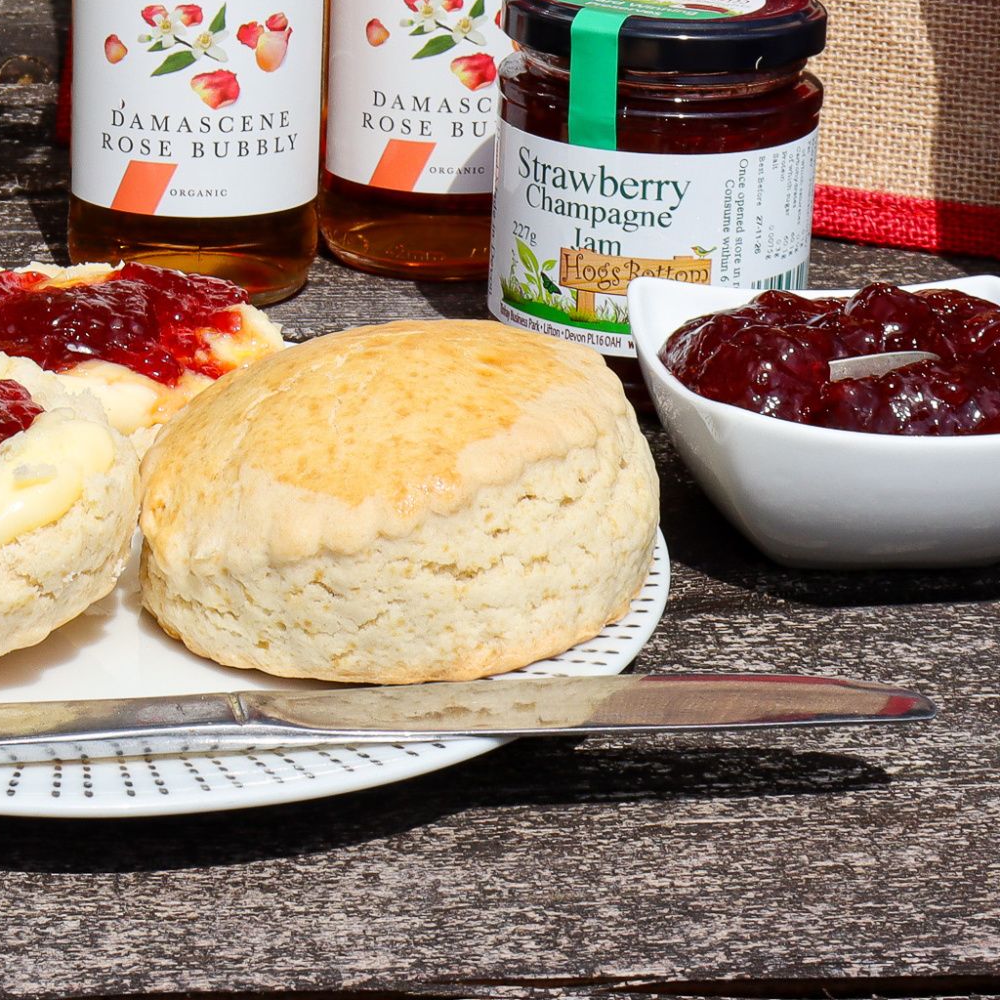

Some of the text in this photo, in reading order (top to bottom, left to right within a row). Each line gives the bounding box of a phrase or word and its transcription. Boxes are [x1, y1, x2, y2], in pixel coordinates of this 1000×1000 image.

[629, 2, 699, 16] Winning
[373, 90, 492, 114] DAMASC
[111, 108, 290, 134] DAMASCENE
[361, 112, 432, 136] ROSE
[101, 132, 298, 158] ROSE BUBBLY
[429, 166, 486, 175] ORGANIC
[518, 146, 692, 211] Strawberry
[739, 158, 748, 188] Once
[758, 156, 766, 175] Best
[169, 188, 228, 198] ORGANIC
[756, 177, 764, 206] Before
[526, 183, 672, 233] Champagne
[723, 180, 735, 232] Consume
[735, 192, 745, 234] opened
[512, 220, 537, 247] 227g
[570, 228, 622, 257] Jam
[720, 236, 732, 272] within
[734, 237, 743, 264] store
[562, 253, 709, 290] Hogs Bottom
[732, 268, 741, 278] in
[510, 310, 528, 328] Business
[528, 318, 540, 332] Park
[543, 322, 561, 337] Lifton
[564, 328, 586, 344] Devon
[587, 332, 604, 346] PL16
